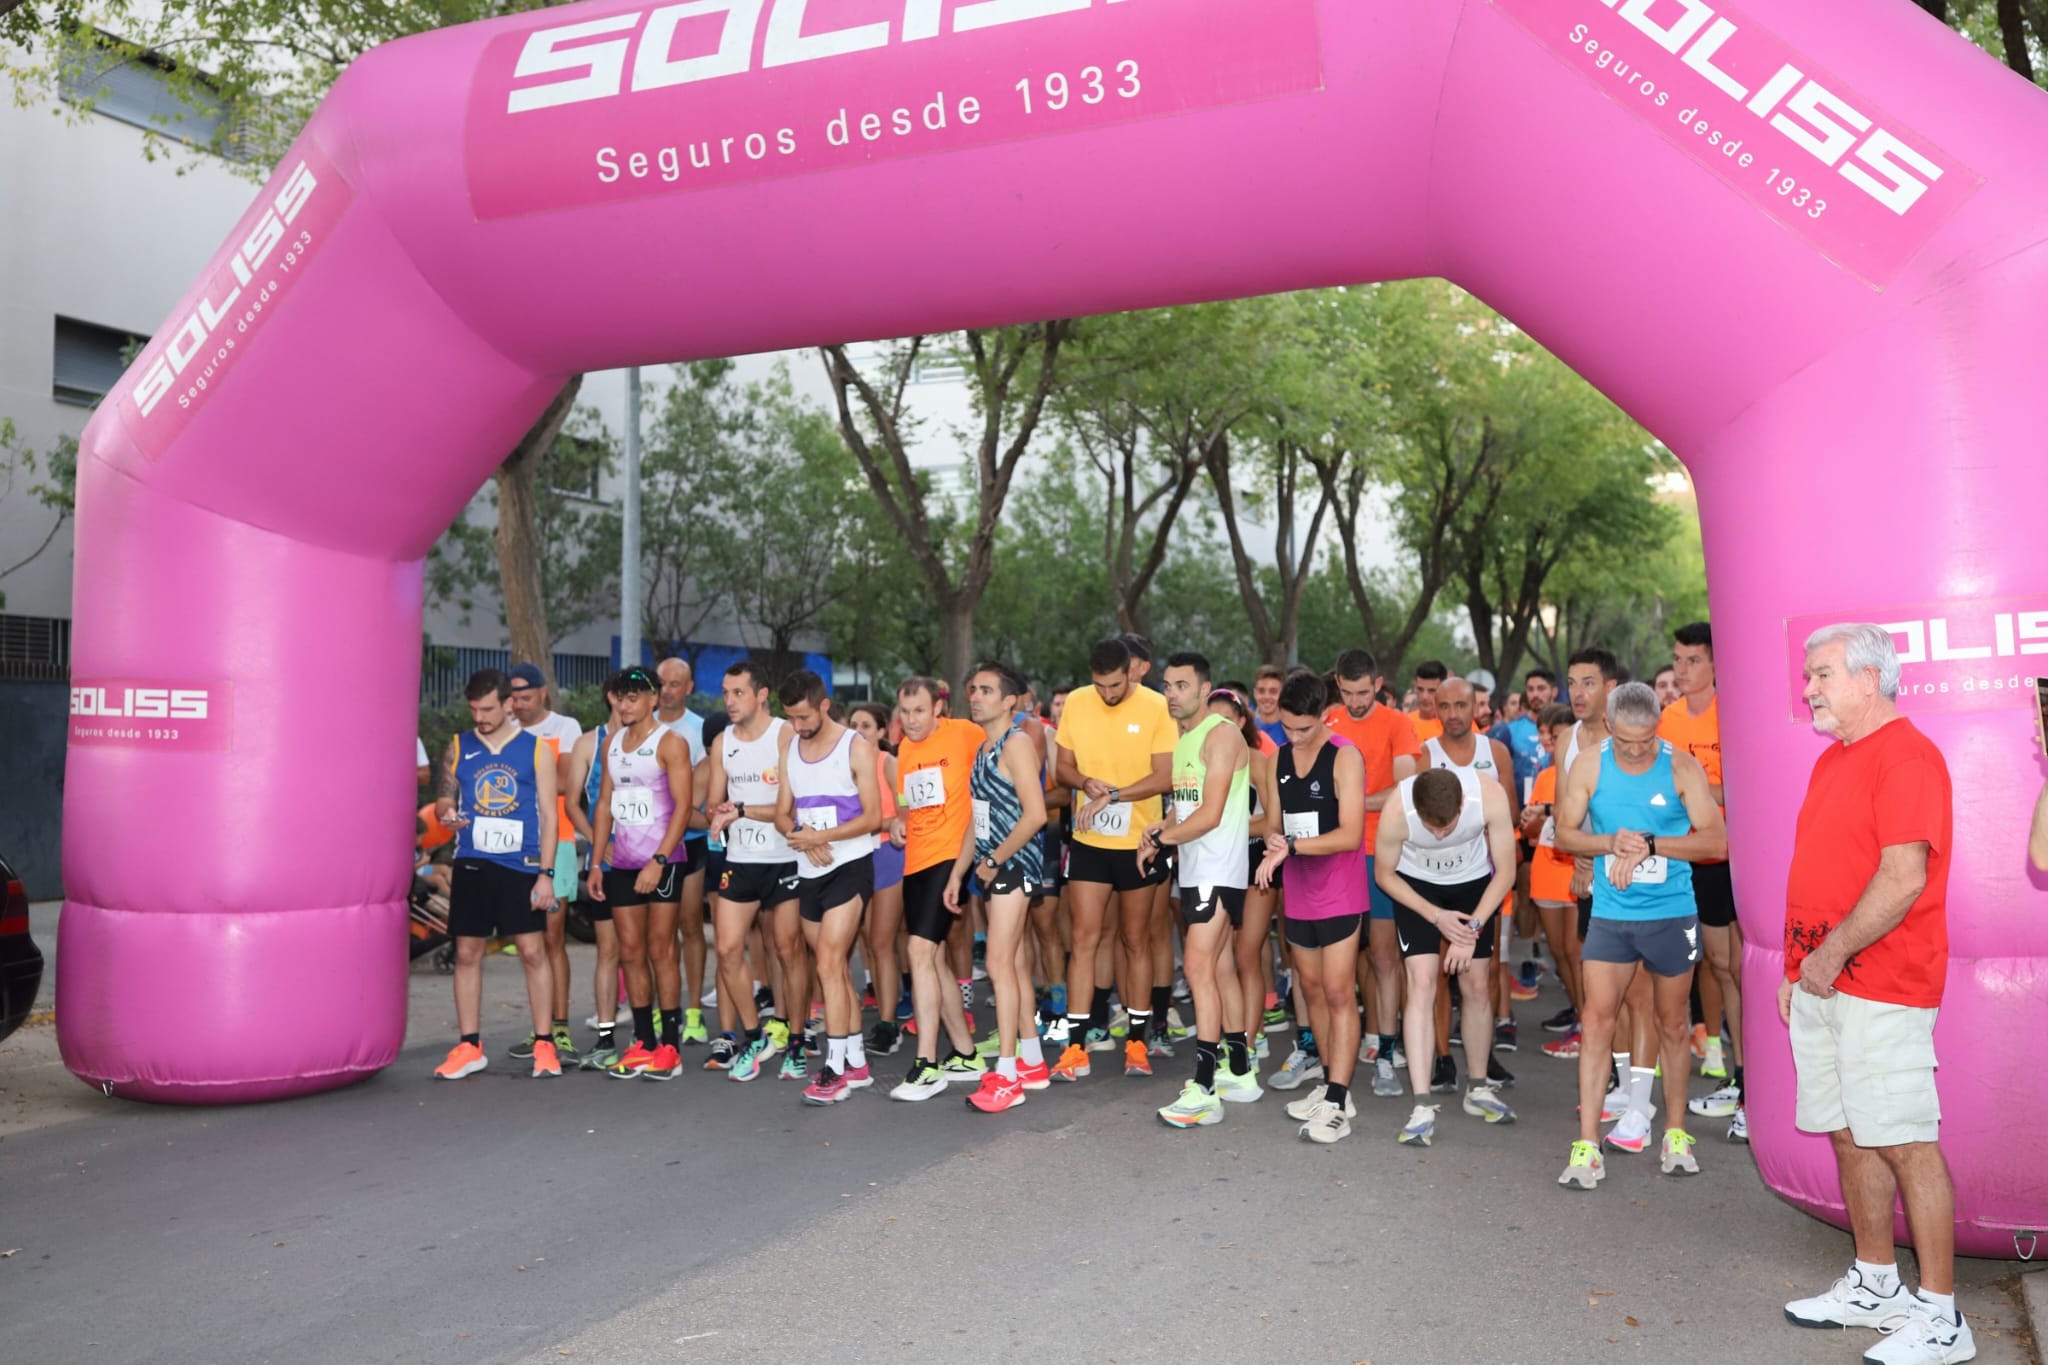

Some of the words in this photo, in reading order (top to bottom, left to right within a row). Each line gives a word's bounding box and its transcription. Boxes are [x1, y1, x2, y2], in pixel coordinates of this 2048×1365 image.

[508, 0, 1129, 113] SOL
[595, 127, 797, 183] Seguros
[825, 91, 981, 147] desde
[1014, 59, 1142, 115] 1933
[1568, 23, 1670, 107] Seguros
[1677, 108, 1754, 168] desde
[1765, 168, 1828, 218] 1933
[1600, 0, 1944, 216] OLISS
[132, 159, 318, 418] SOLISS
[177, 337, 236, 410] Seguros
[237, 280, 279, 334] desde
[279, 230, 313, 273] 1933
[1877, 610, 2048, 665] OLIS
[70, 687, 208, 719] SOLISS
[1898, 680, 1950, 697] uros
[1962, 674, 2034, 692] desde
[74, 726, 104, 739] Seguros
[106, 727, 142, 739] desde
[147, 728, 180, 741] 1933
[618, 802, 649, 820] 270
[911, 782, 935, 803] 132
[484, 830, 515, 848] 170
[737, 828, 766, 845] 176
